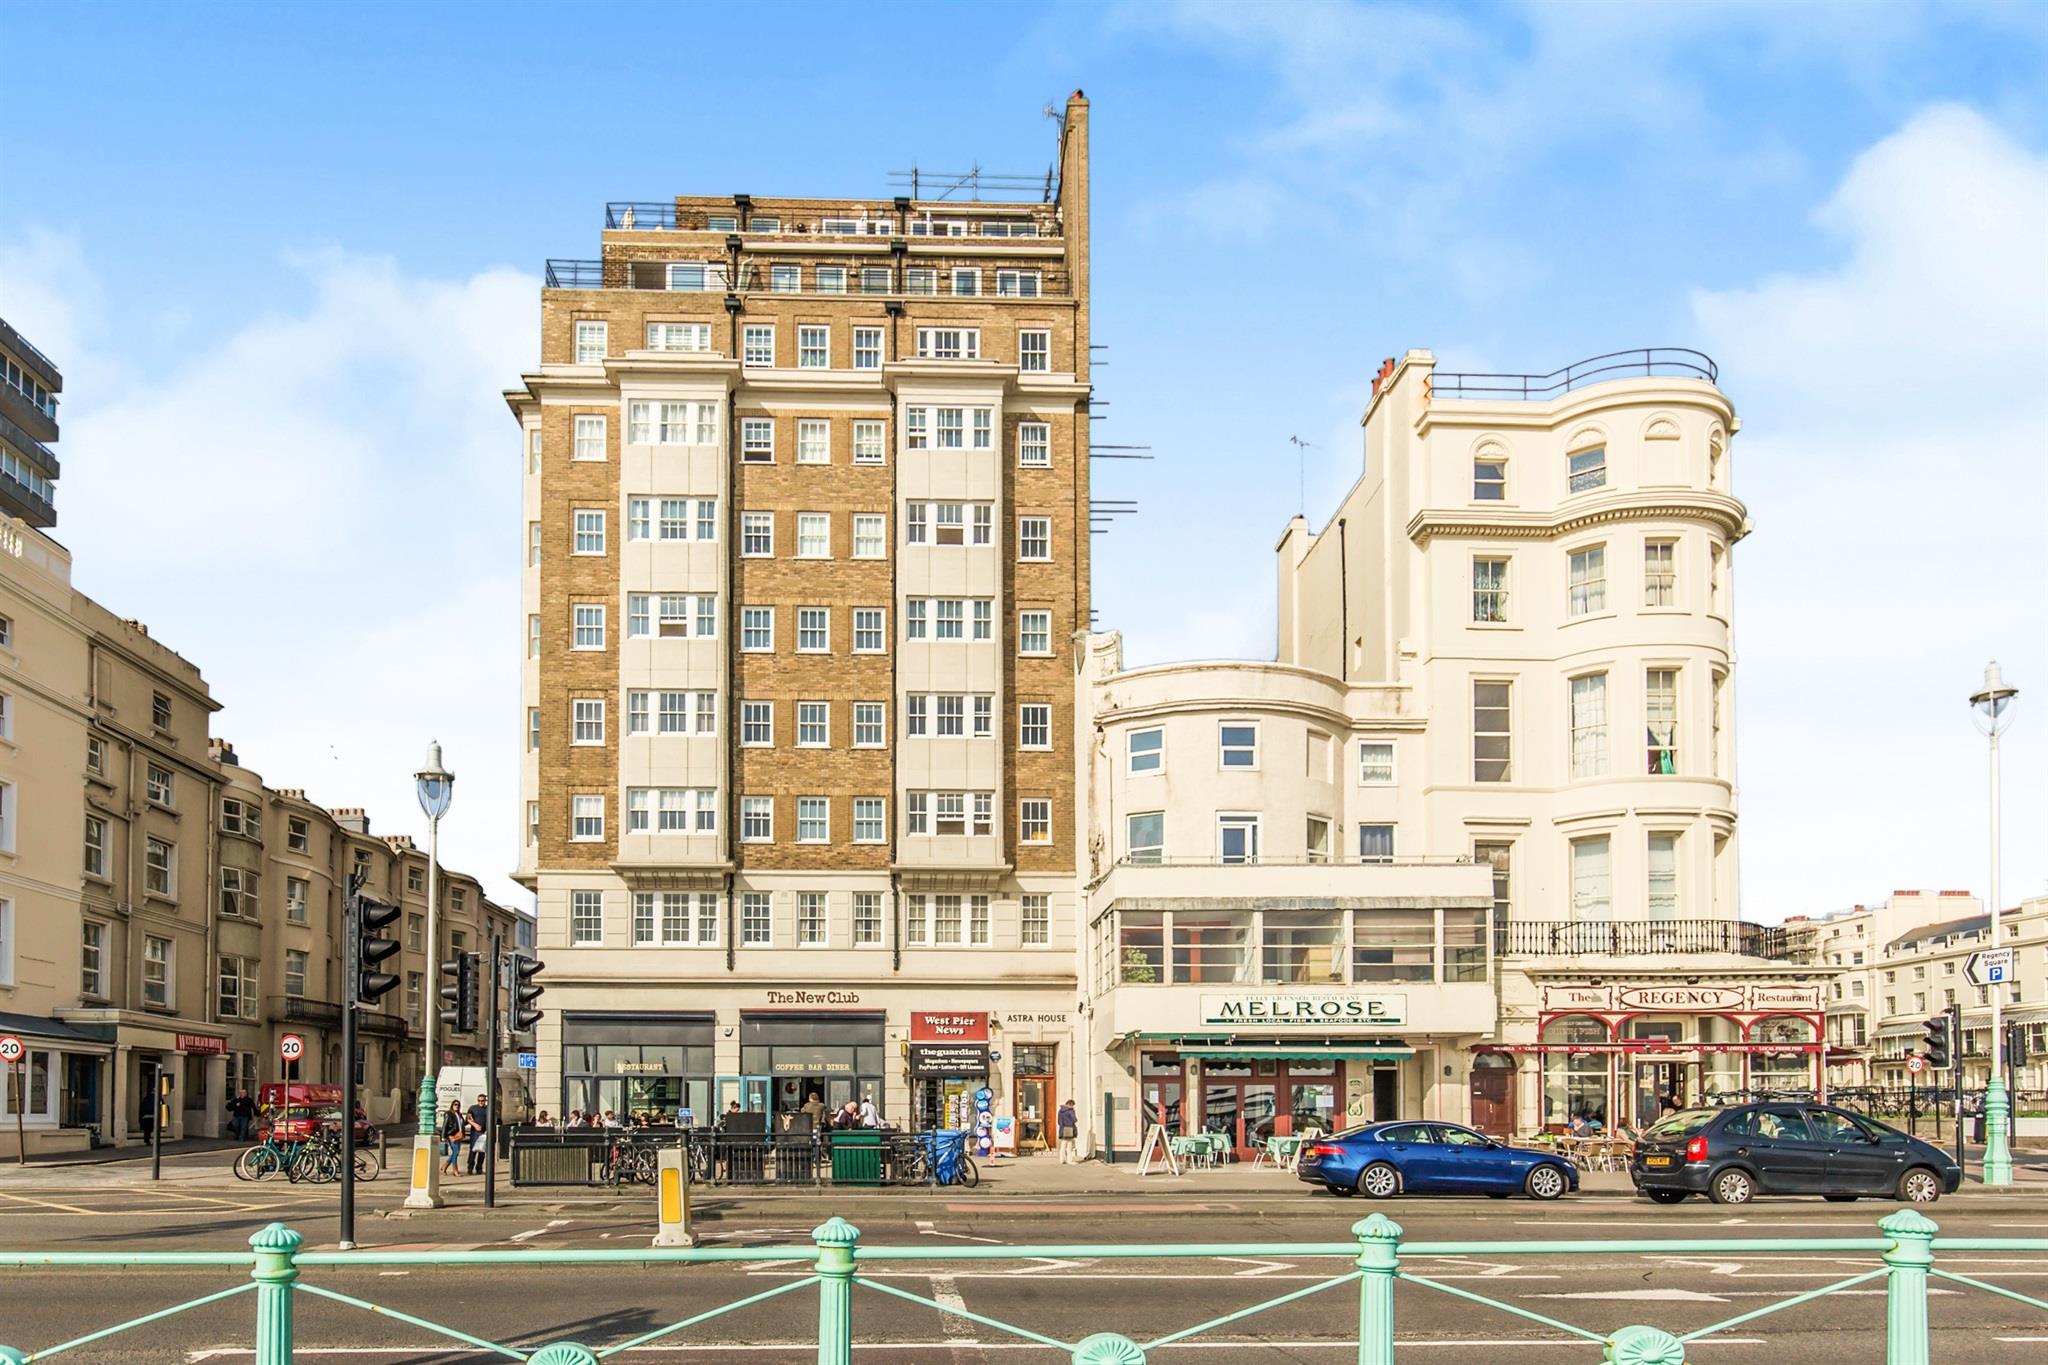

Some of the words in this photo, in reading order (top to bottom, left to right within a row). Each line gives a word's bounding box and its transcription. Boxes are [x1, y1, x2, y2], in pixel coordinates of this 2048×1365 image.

[1992, 969, 2000, 980] P
[767, 991, 794, 1003] The
[795, 991, 825, 1003] New
[827, 991, 860, 1003] Club
[1568, 992, 1591, 1002] The
[1639, 991, 1723, 1004] REGENCY
[1758, 992, 1812, 1002] Restaurant
[1220, 1001, 1386, 1017] MELROSE
[924, 1016, 950, 1025] West
[952, 1016, 976, 1025] Pier
[1007, 1014, 1034, 1022] ASTRA
[1038, 1014, 1067, 1022] HOUSE
[935, 1026, 965, 1035] News
[178, 1034, 194, 1049] WEST
[1, 1043, 19, 1054] 20
[282, 1042, 300, 1053] 20
[920, 1048, 982, 1056] theguardian
